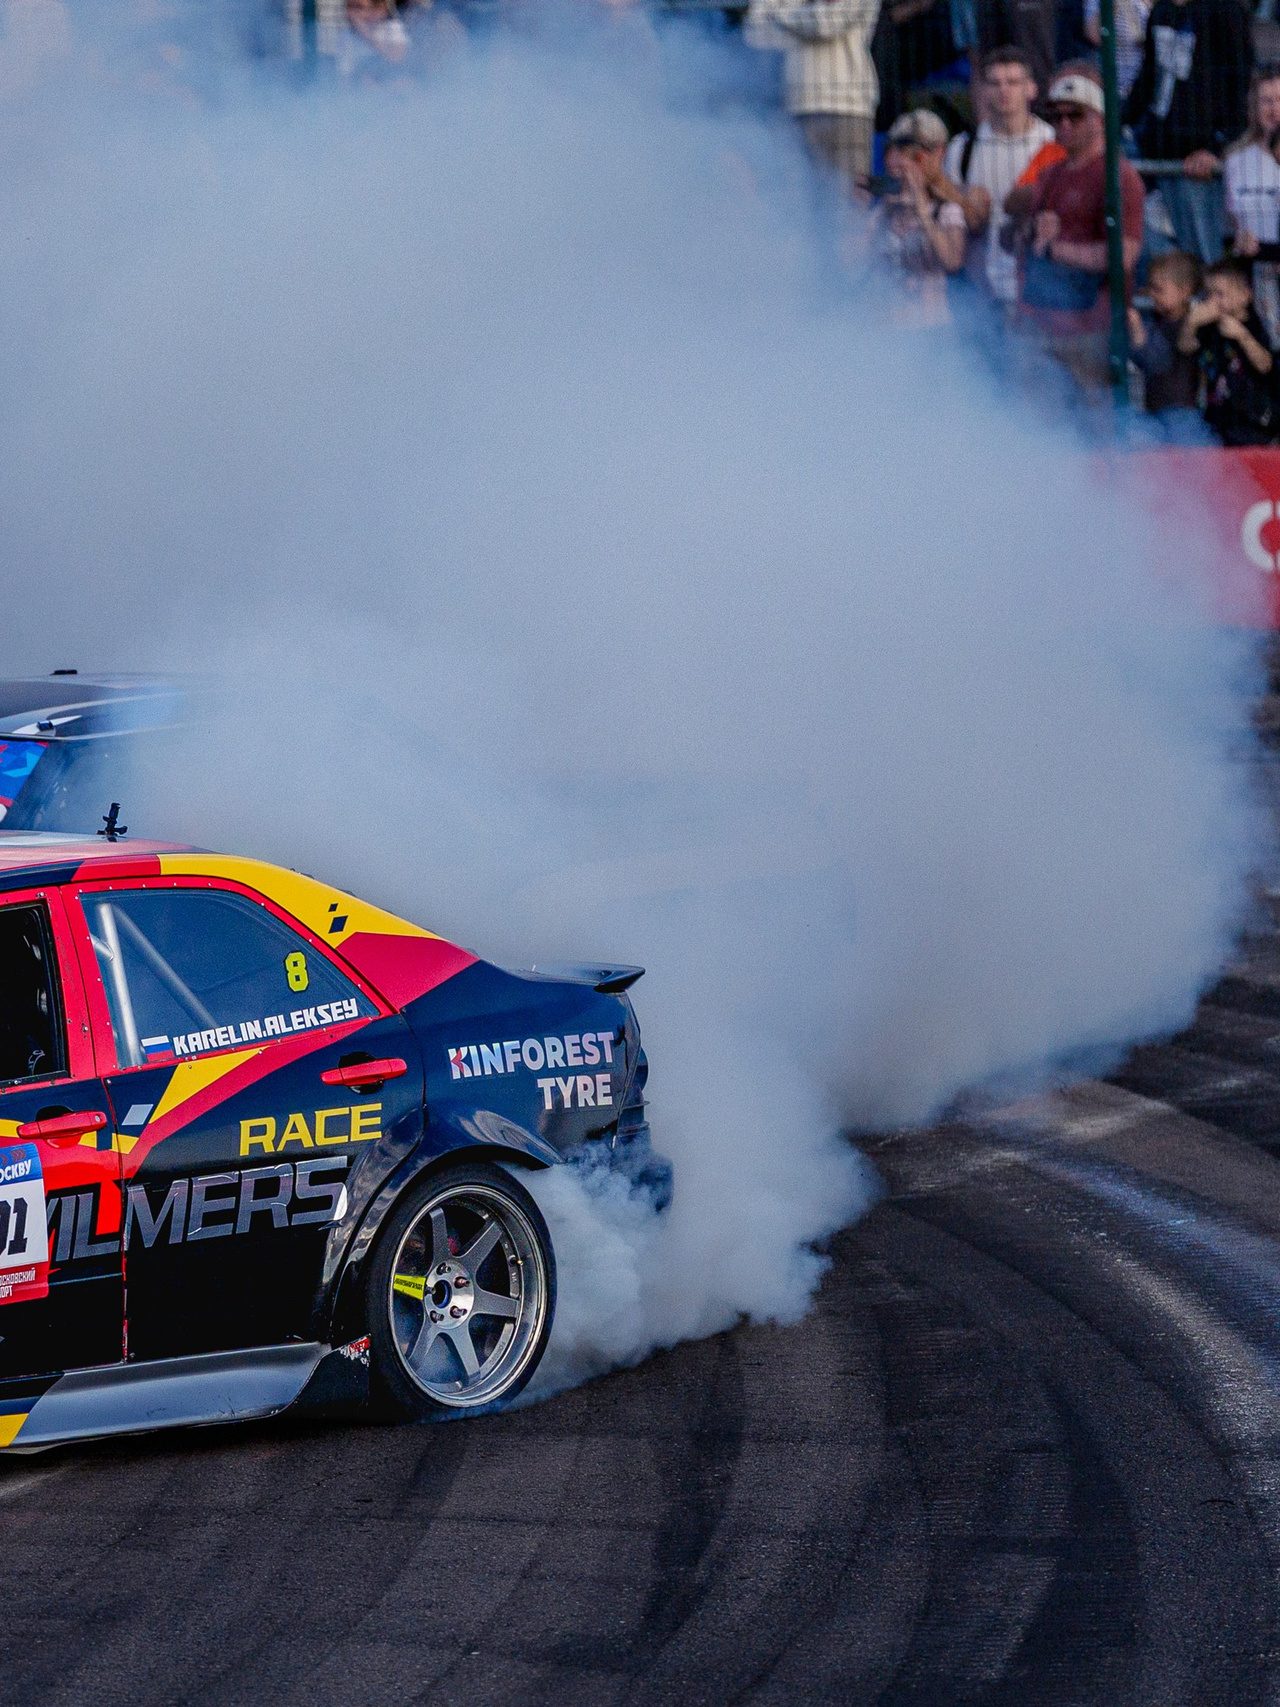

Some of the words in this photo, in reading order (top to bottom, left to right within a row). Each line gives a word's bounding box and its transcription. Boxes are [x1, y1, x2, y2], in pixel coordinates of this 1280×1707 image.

[285, 951, 310, 992] 8
[172, 998, 359, 1056] KARELIN.ALEKSEY
[448, 1031, 615, 1080] KINFOREST
[537, 1073, 613, 1110] TYRE
[239, 1102, 383, 1157] RACE
[46, 1155, 348, 1262] ILMERS
